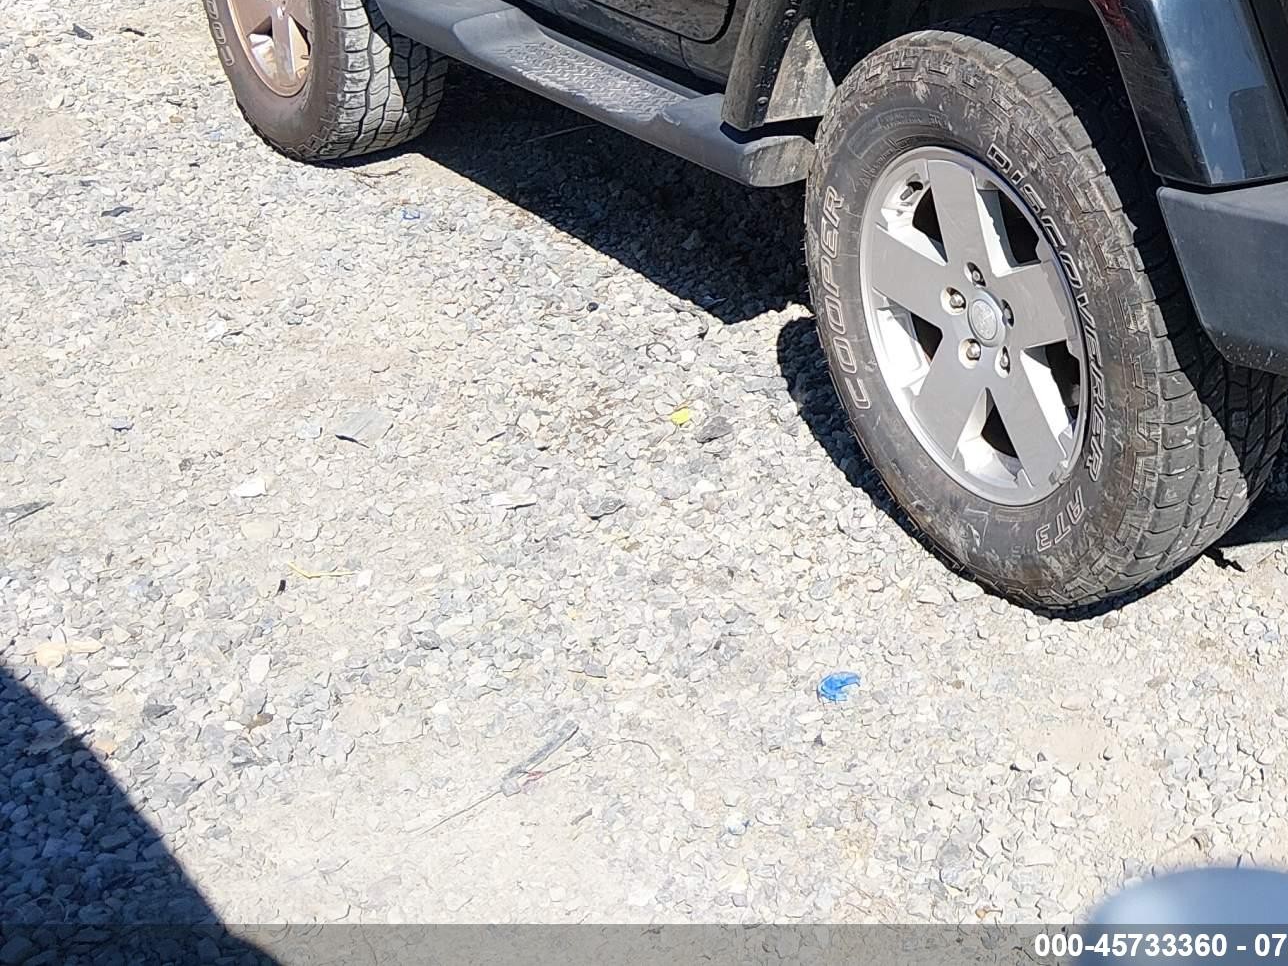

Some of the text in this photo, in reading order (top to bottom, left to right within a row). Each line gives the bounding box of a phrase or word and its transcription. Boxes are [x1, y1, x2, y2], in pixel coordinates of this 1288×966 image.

[819, 185, 872, 410] COOPER
[987, 143, 1103, 554] DISCOVERER AT3
